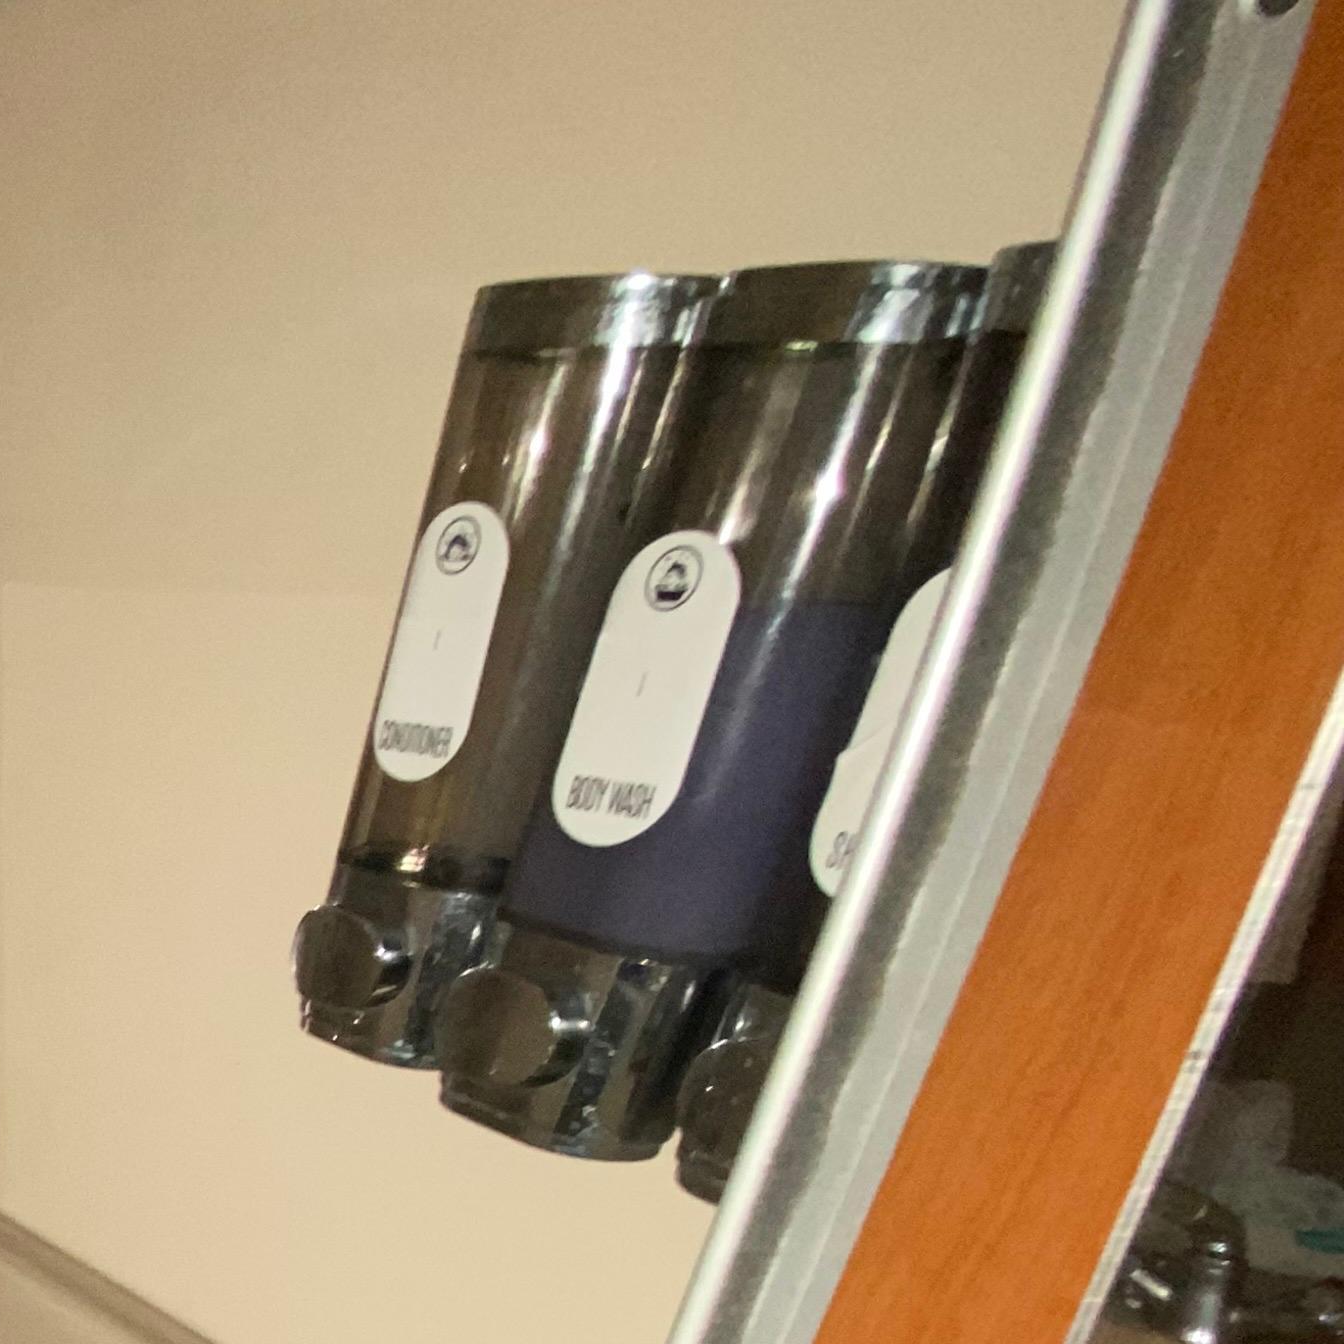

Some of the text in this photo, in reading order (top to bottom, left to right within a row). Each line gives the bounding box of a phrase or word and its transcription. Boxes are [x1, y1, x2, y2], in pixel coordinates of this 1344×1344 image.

[378, 719, 455, 759] CONDITIONER
[566, 774, 657, 820] BODY WASH
